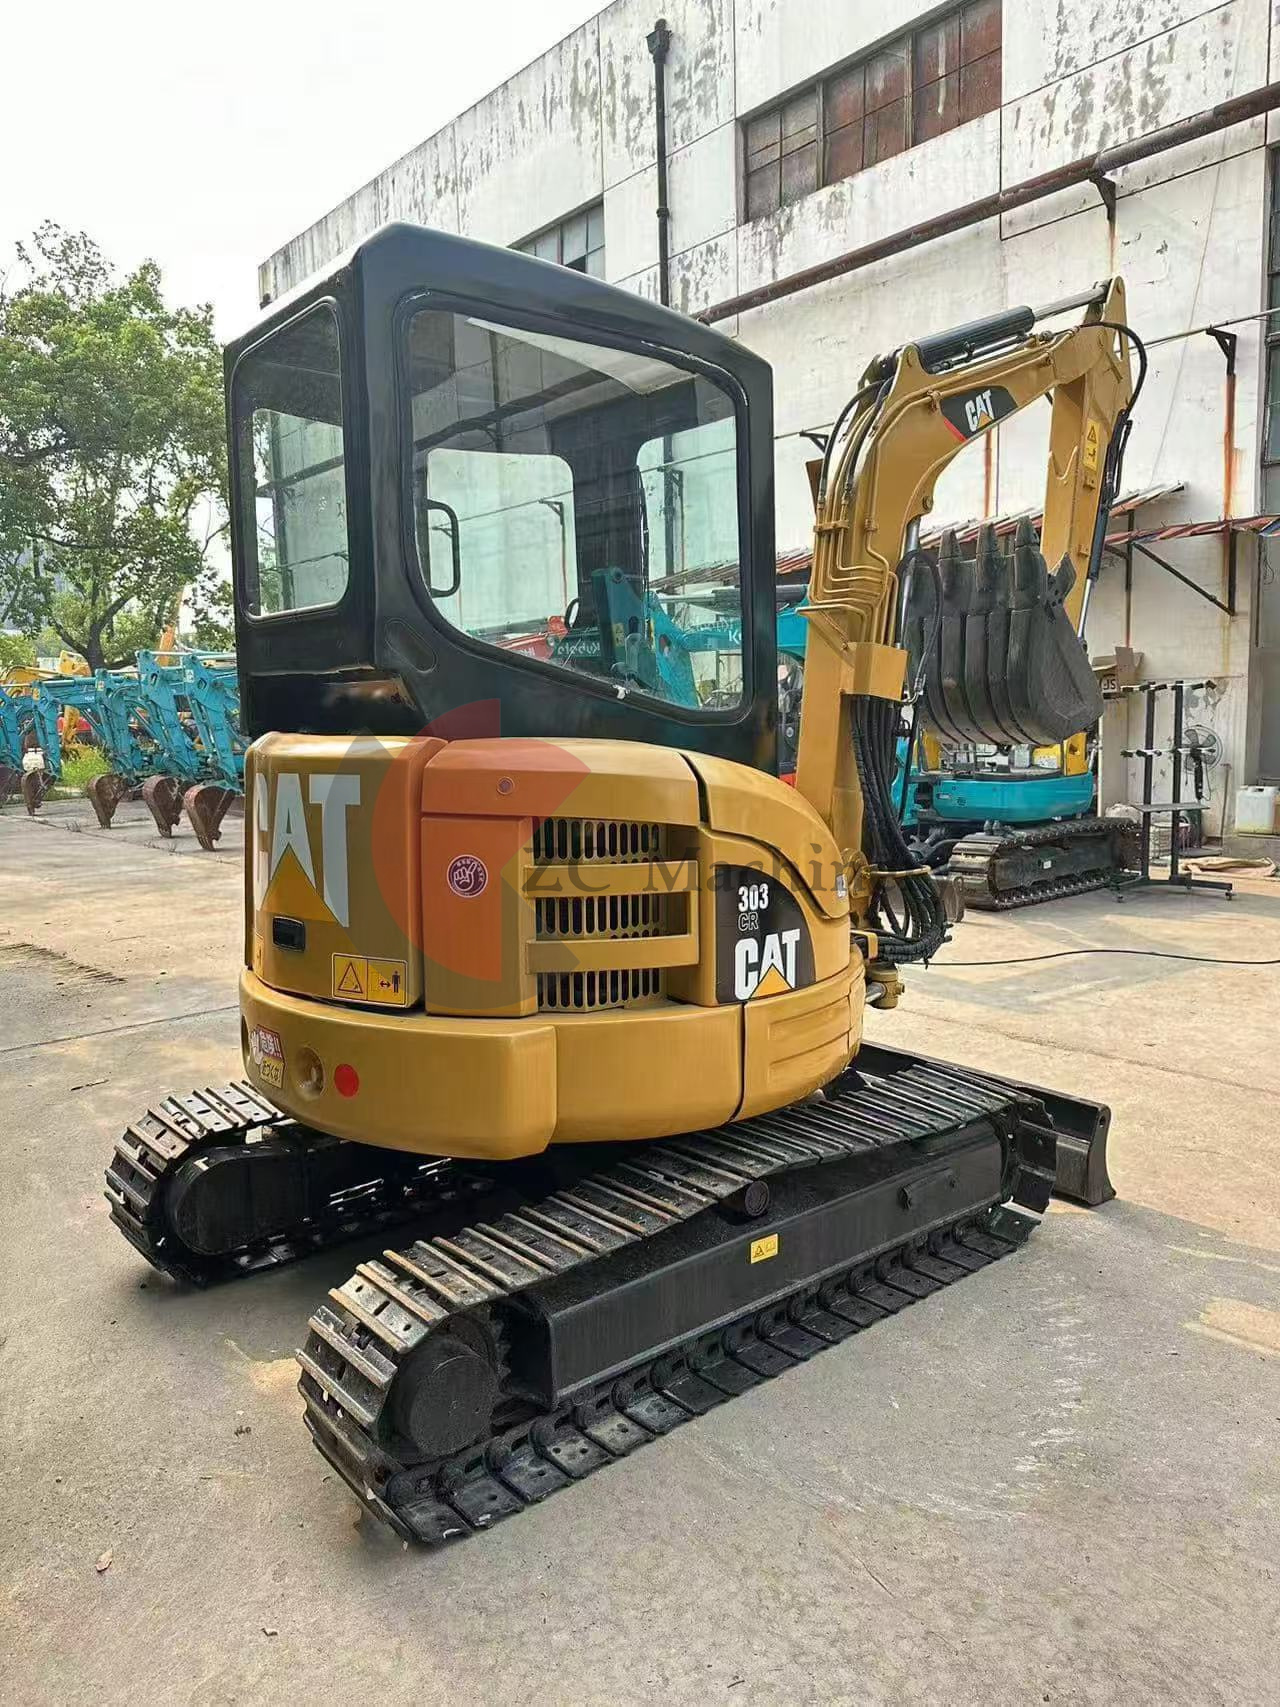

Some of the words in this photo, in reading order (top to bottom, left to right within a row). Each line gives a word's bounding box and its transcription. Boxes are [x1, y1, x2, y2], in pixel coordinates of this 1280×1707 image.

[965, 389, 995, 432] CAT
[253, 773, 361, 928] CAT
[738, 882, 769, 912] 303
[737, 911, 759, 932] CR
[734, 928, 801, 1001] CAT
